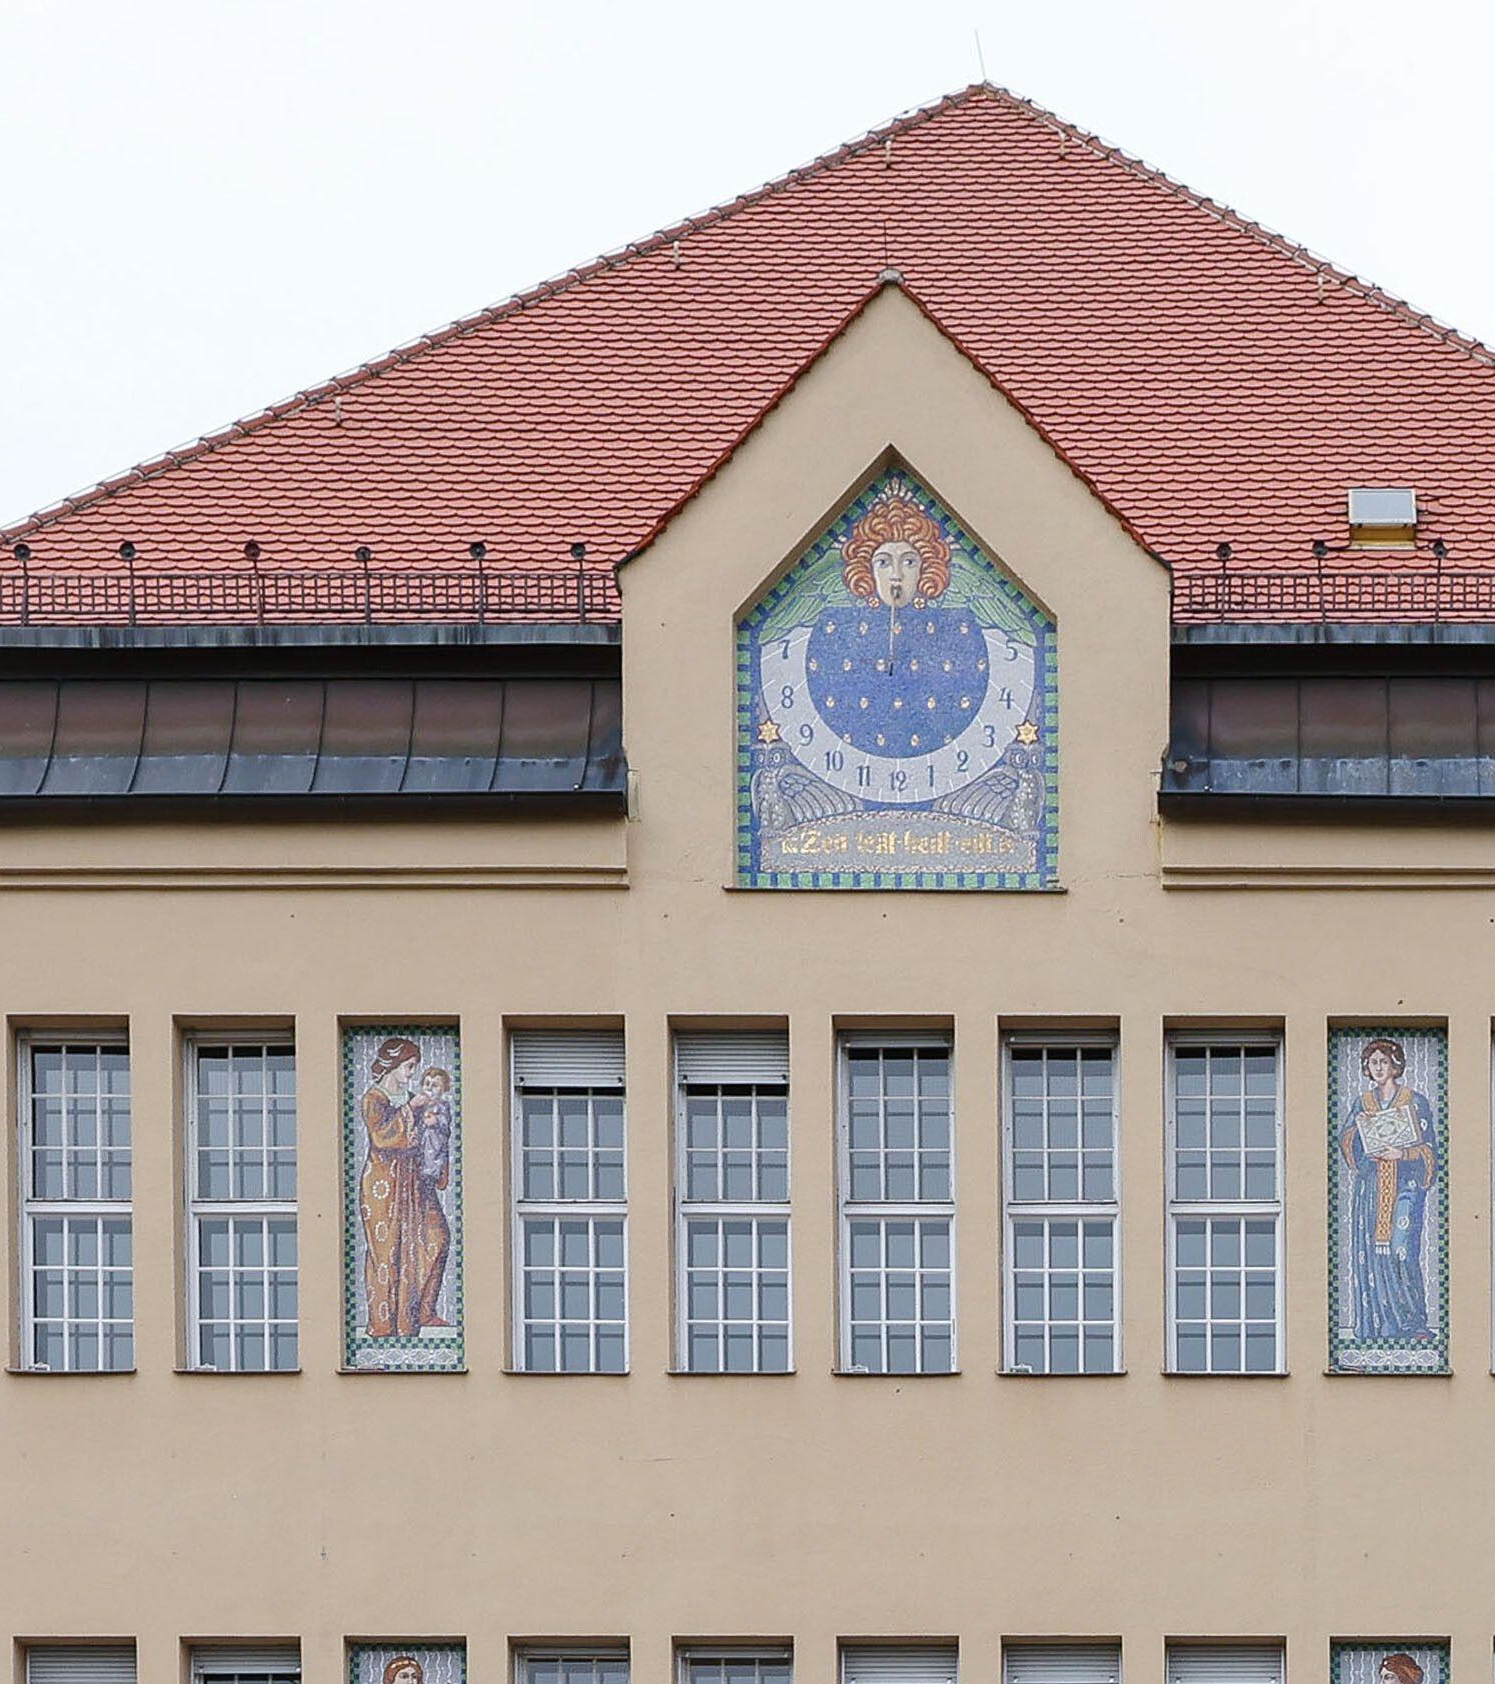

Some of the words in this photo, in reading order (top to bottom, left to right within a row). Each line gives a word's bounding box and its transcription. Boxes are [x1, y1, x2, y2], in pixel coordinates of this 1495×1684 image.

[1005, 641, 1018, 661] 5
[782, 685, 794, 708] 8
[1000, 688, 1012, 709] 4
[800, 724, 813, 746] 9
[983, 725, 995, 747] 3
[825, 751, 843, 770] 10
[958, 751, 968, 772] 2
[858, 767, 870, 786] 11
[891, 771, 906, 792] 12
[927, 766, 934, 786] 1
